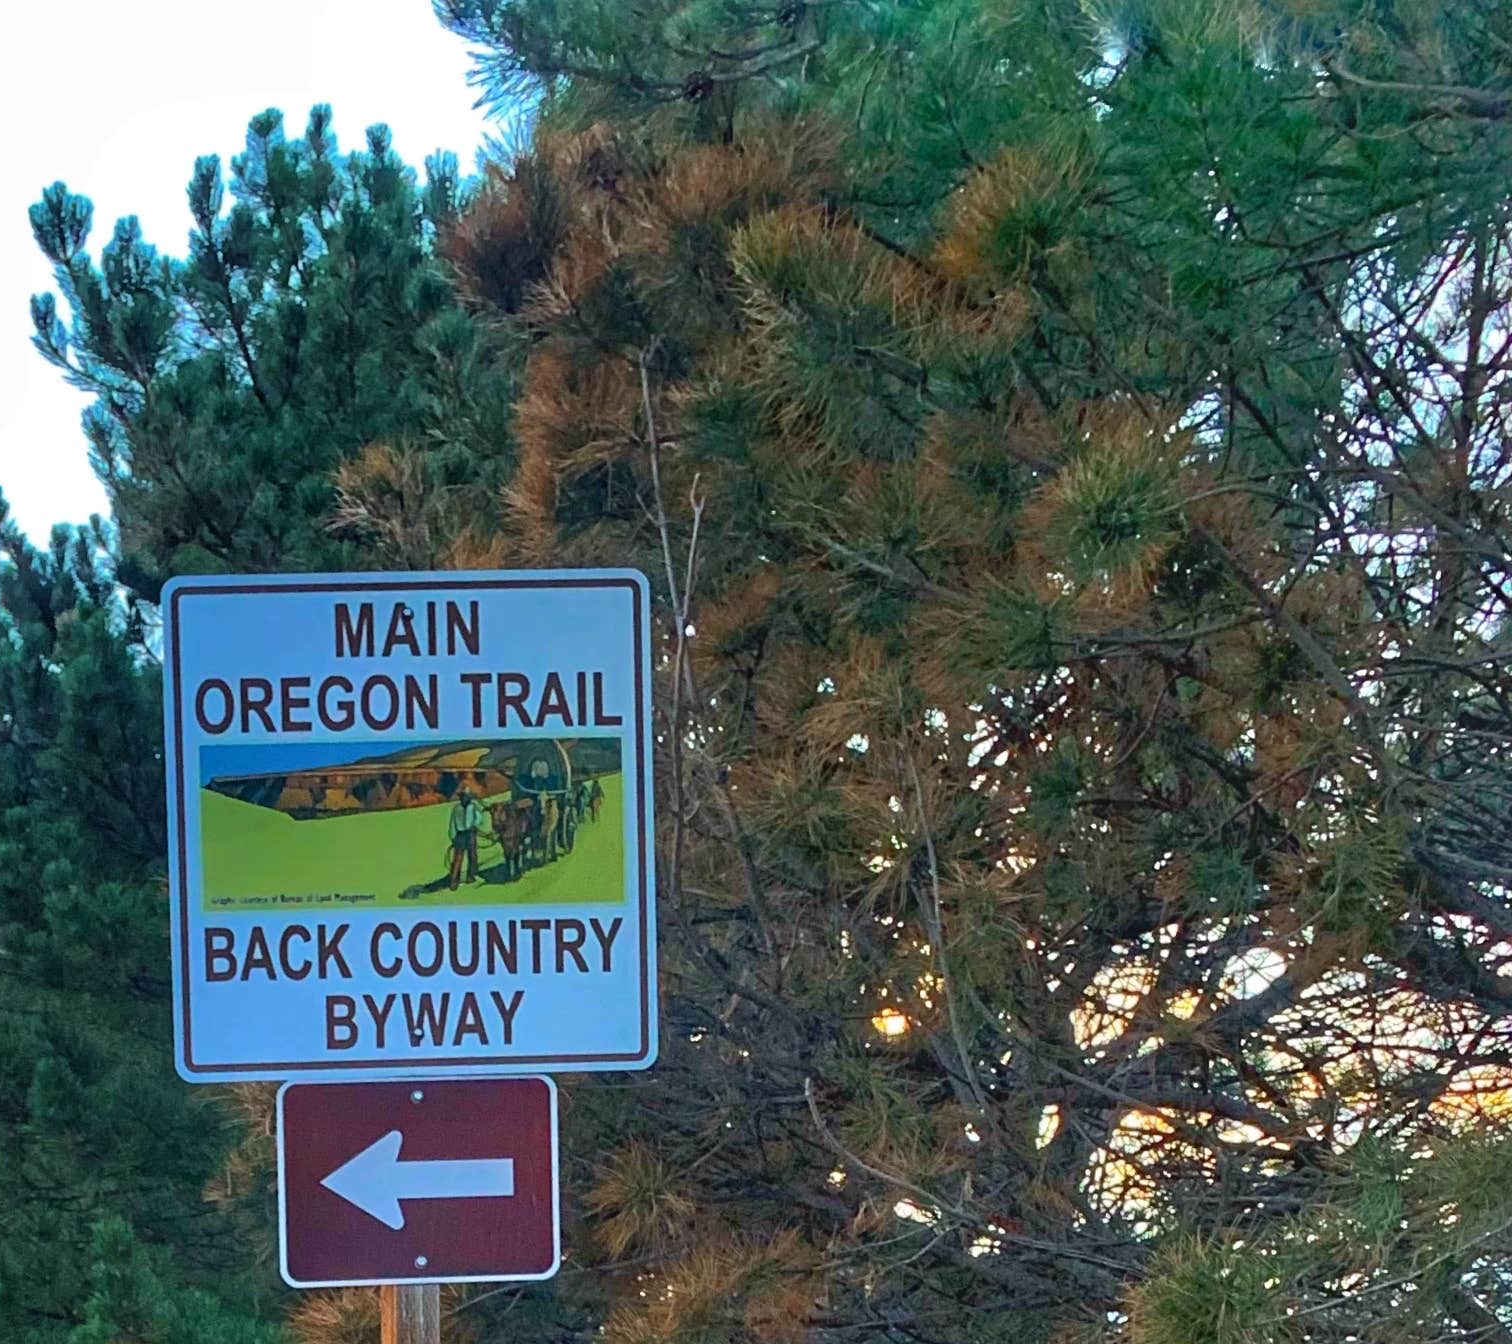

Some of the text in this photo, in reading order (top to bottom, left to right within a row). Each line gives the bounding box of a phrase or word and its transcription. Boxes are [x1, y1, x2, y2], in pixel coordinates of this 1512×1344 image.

[334, 601, 480, 658] MAIN
[195, 671, 623, 735] OREGON TRAIL
[204, 917, 623, 983] BACK COUNTRY
[325, 990, 525, 1050] BYWAY
